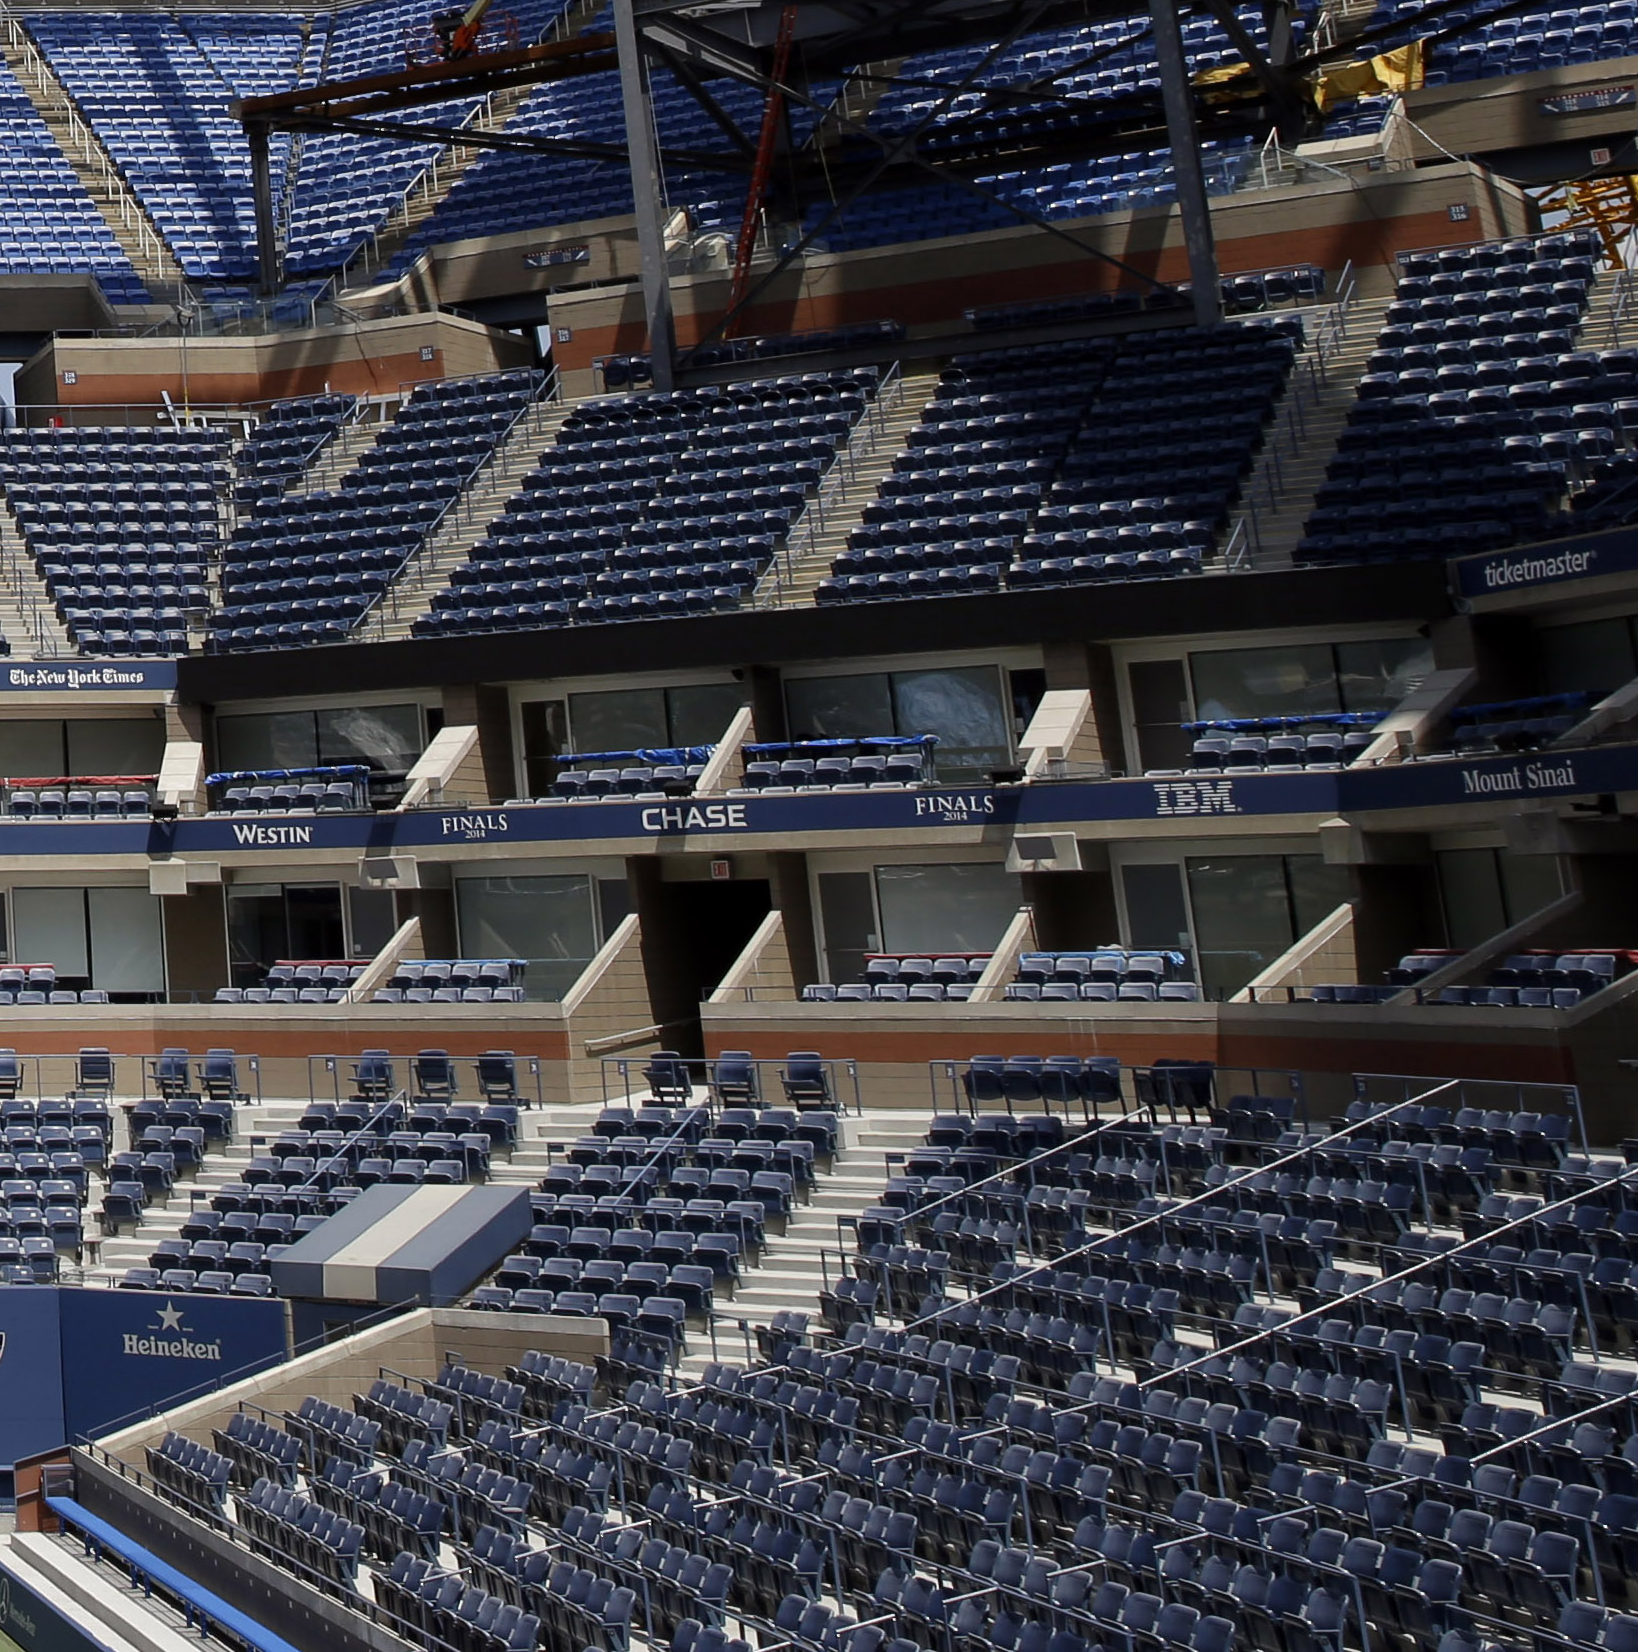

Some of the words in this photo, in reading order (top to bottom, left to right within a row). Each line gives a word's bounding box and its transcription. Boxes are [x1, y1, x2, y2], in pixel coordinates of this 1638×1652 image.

[1485, 551, 1590, 587] ticketmaster
[9, 669, 35, 688] The
[35, 669, 65, 686] New
[66, 669, 102, 689] York
[102, 668, 144, 686] Times
[1462, 767, 1522, 794] Mount
[1527, 759, 1577, 789] Sinai
[915, 794, 995, 816] FINALS
[1153, 781, 1235, 815] IBM
[441, 814, 508, 835] FINALS
[641, 804, 748, 831] CHASE
[943, 811, 968, 822] 2014
[464, 829, 485, 839] 2014
[122, 1334, 221, 1360] Heineken
